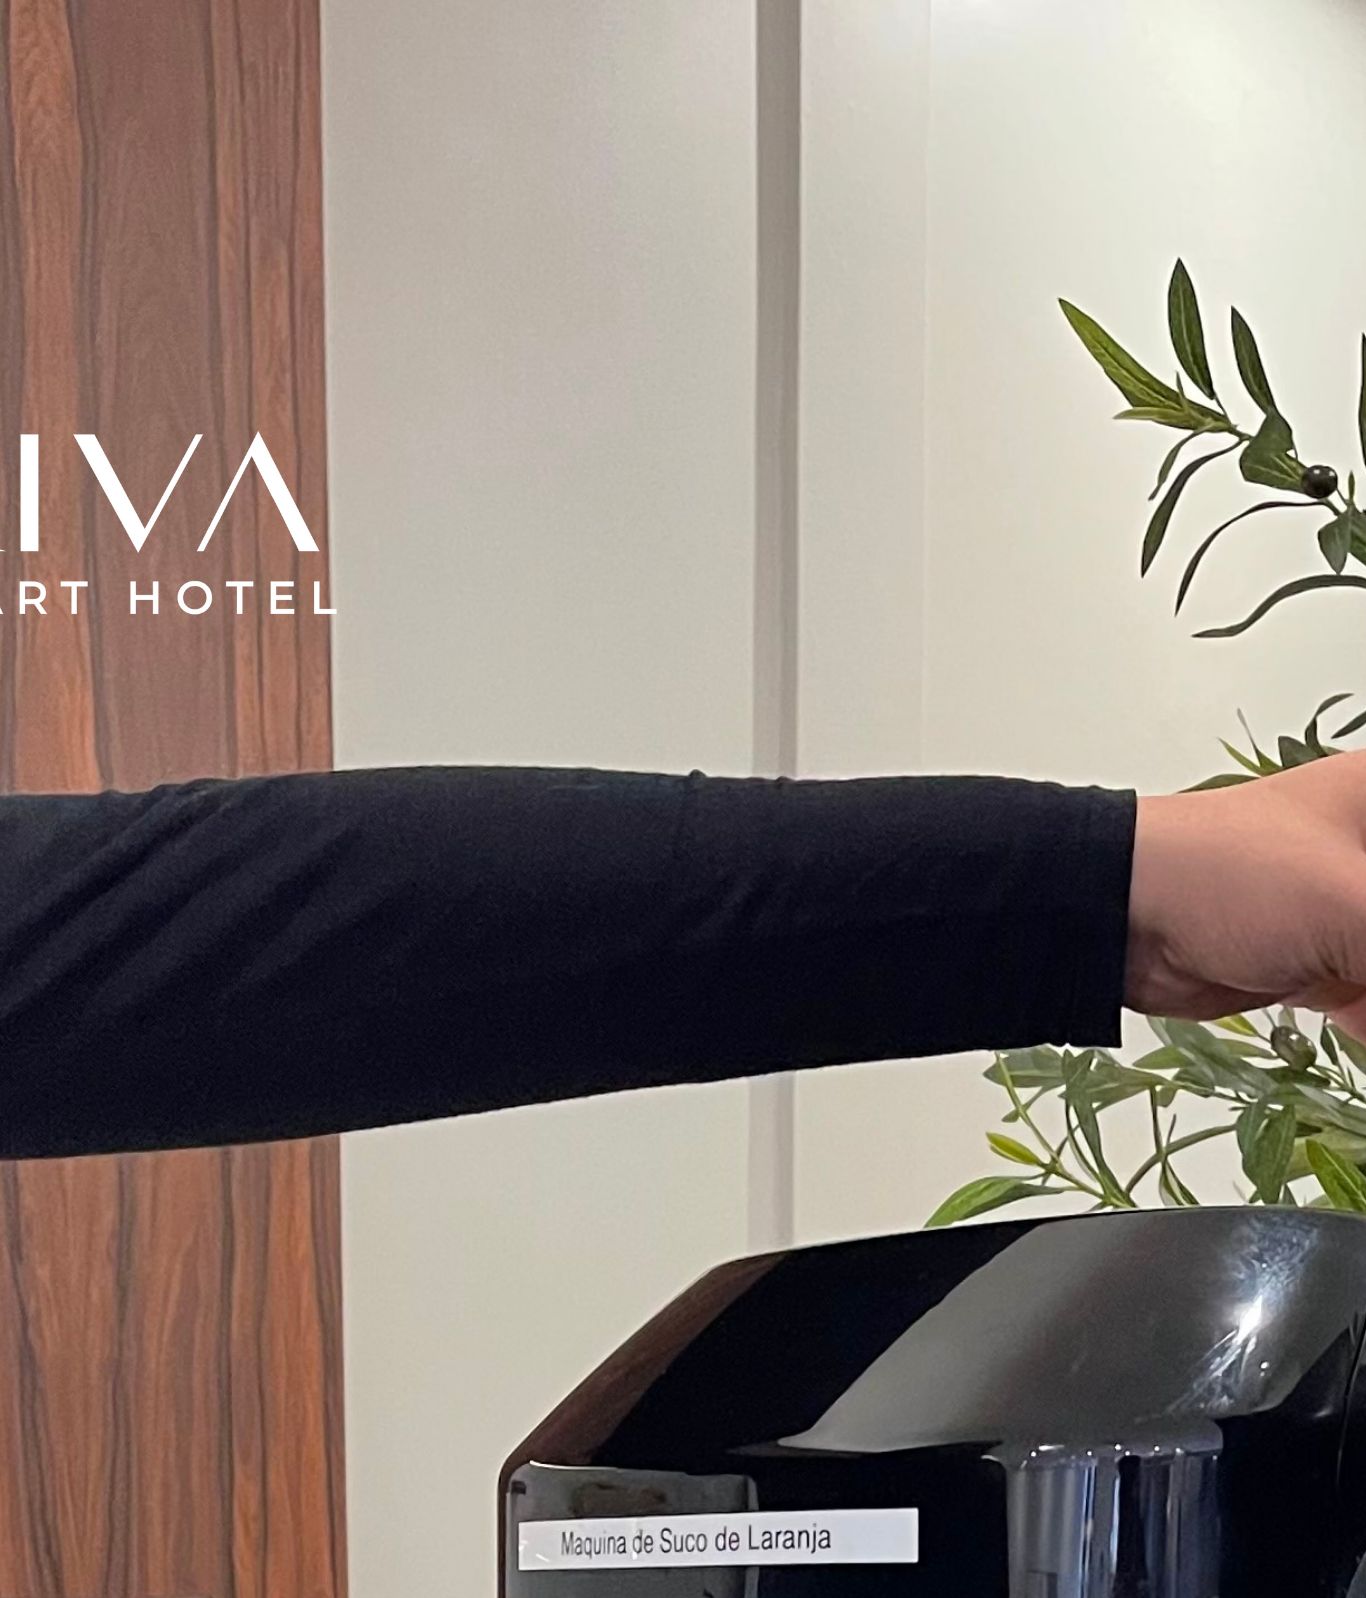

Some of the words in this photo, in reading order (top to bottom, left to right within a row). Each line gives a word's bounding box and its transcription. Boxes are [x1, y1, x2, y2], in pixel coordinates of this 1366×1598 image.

[560, 1530, 628, 1559] Maquina
[632, 1529, 654, 1555] de
[659, 1527, 708, 1554] Suco
[714, 1525, 740, 1552] de
[748, 1522, 832, 1554] Laranja
